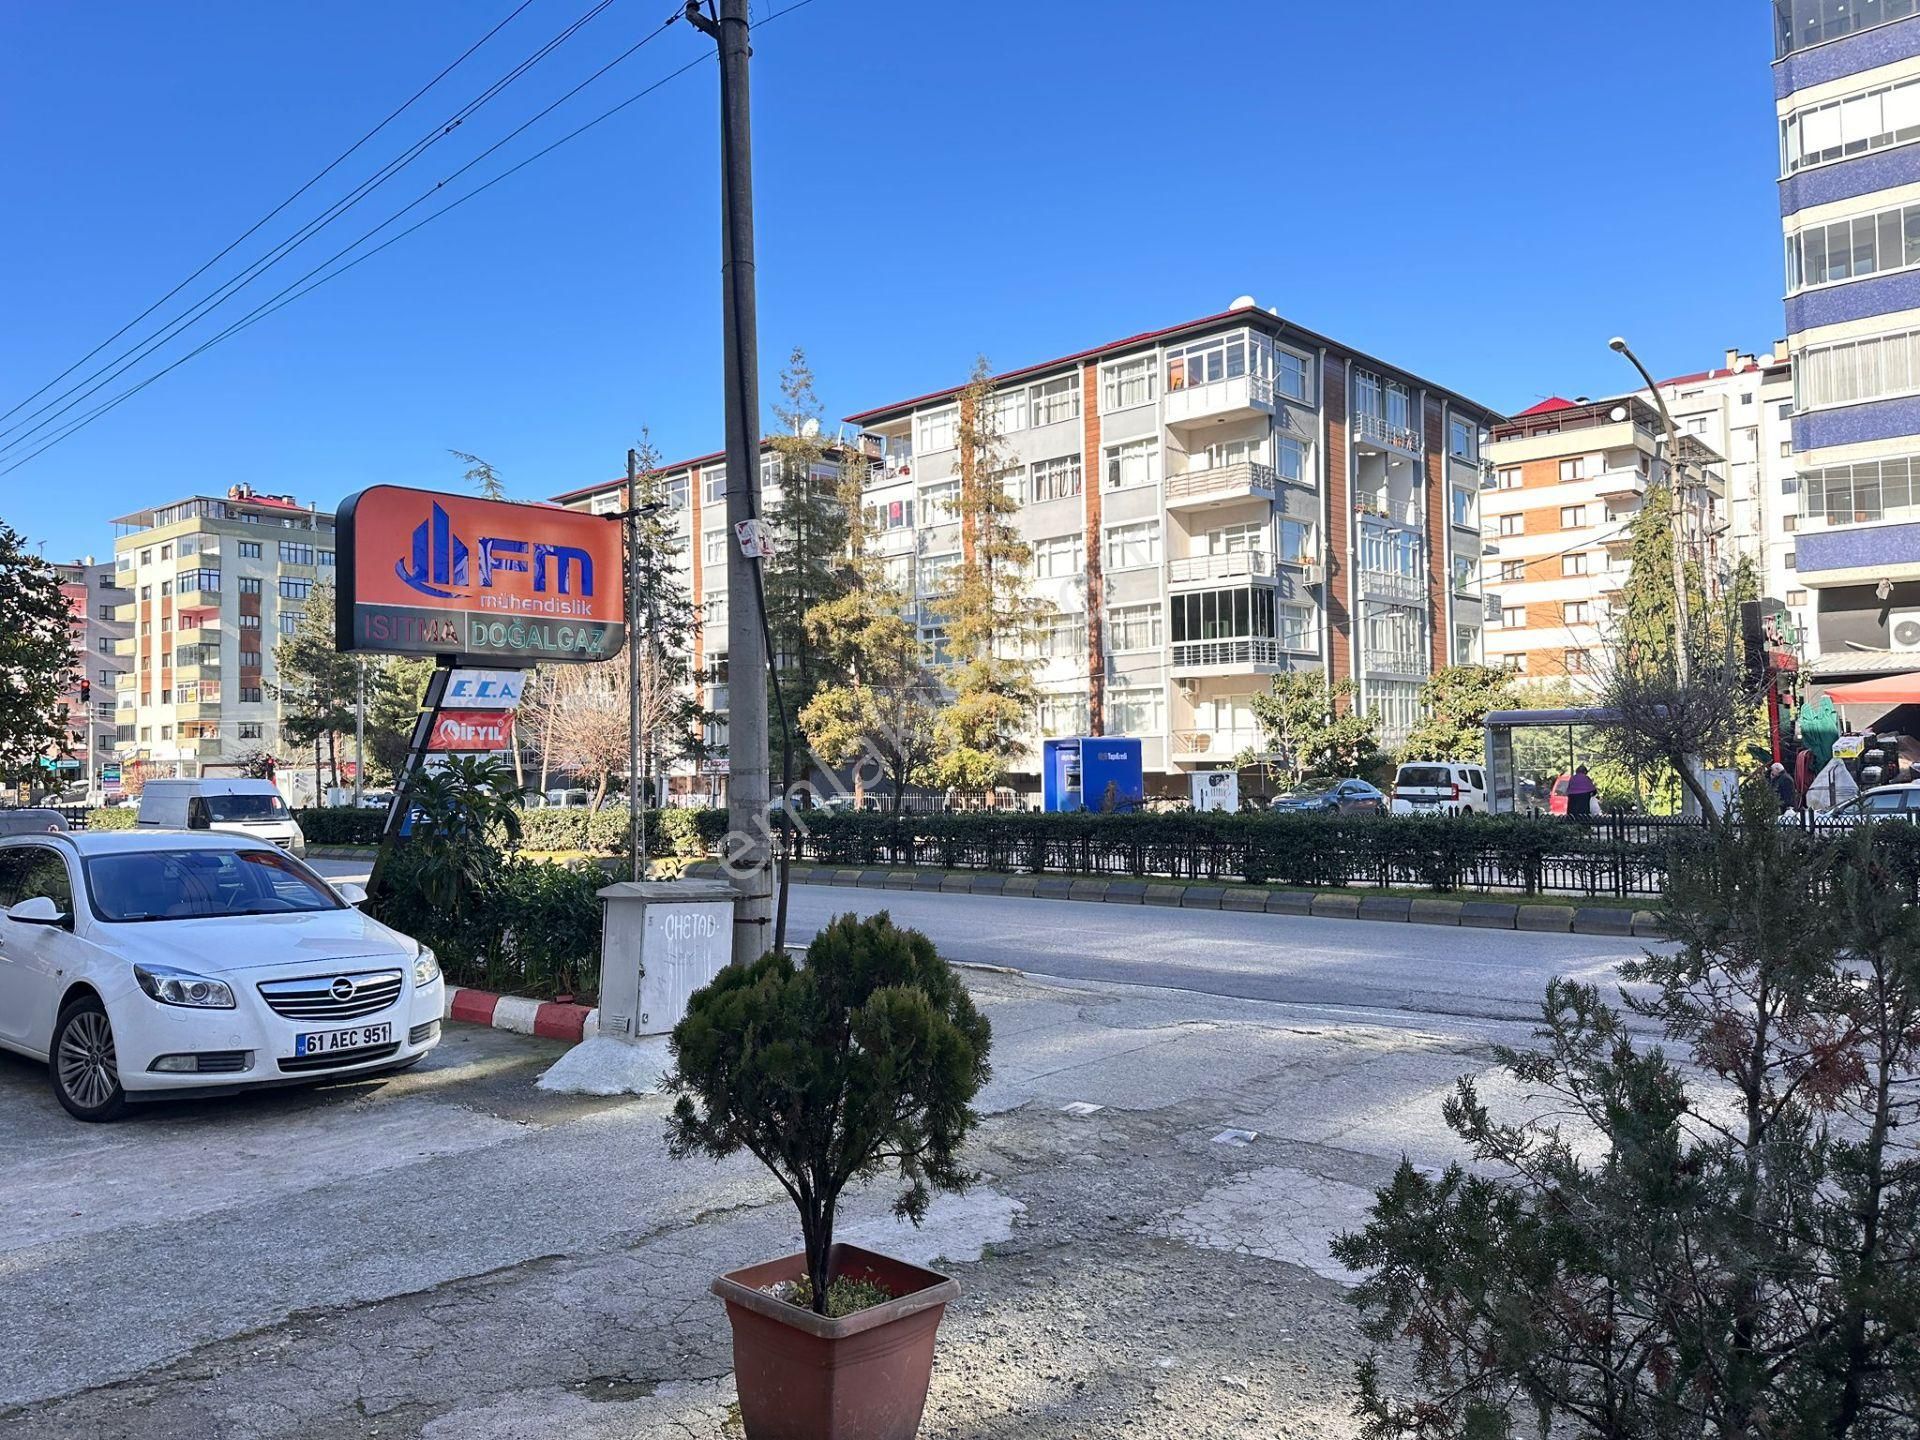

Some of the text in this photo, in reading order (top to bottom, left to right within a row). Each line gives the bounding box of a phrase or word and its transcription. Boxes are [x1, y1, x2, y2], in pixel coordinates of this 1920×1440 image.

[480, 592, 592, 616] mühendislik
[471, 617, 605, 653] DOĞALGAZ
[307, 1026, 387, 1052] 61 AEC 951
